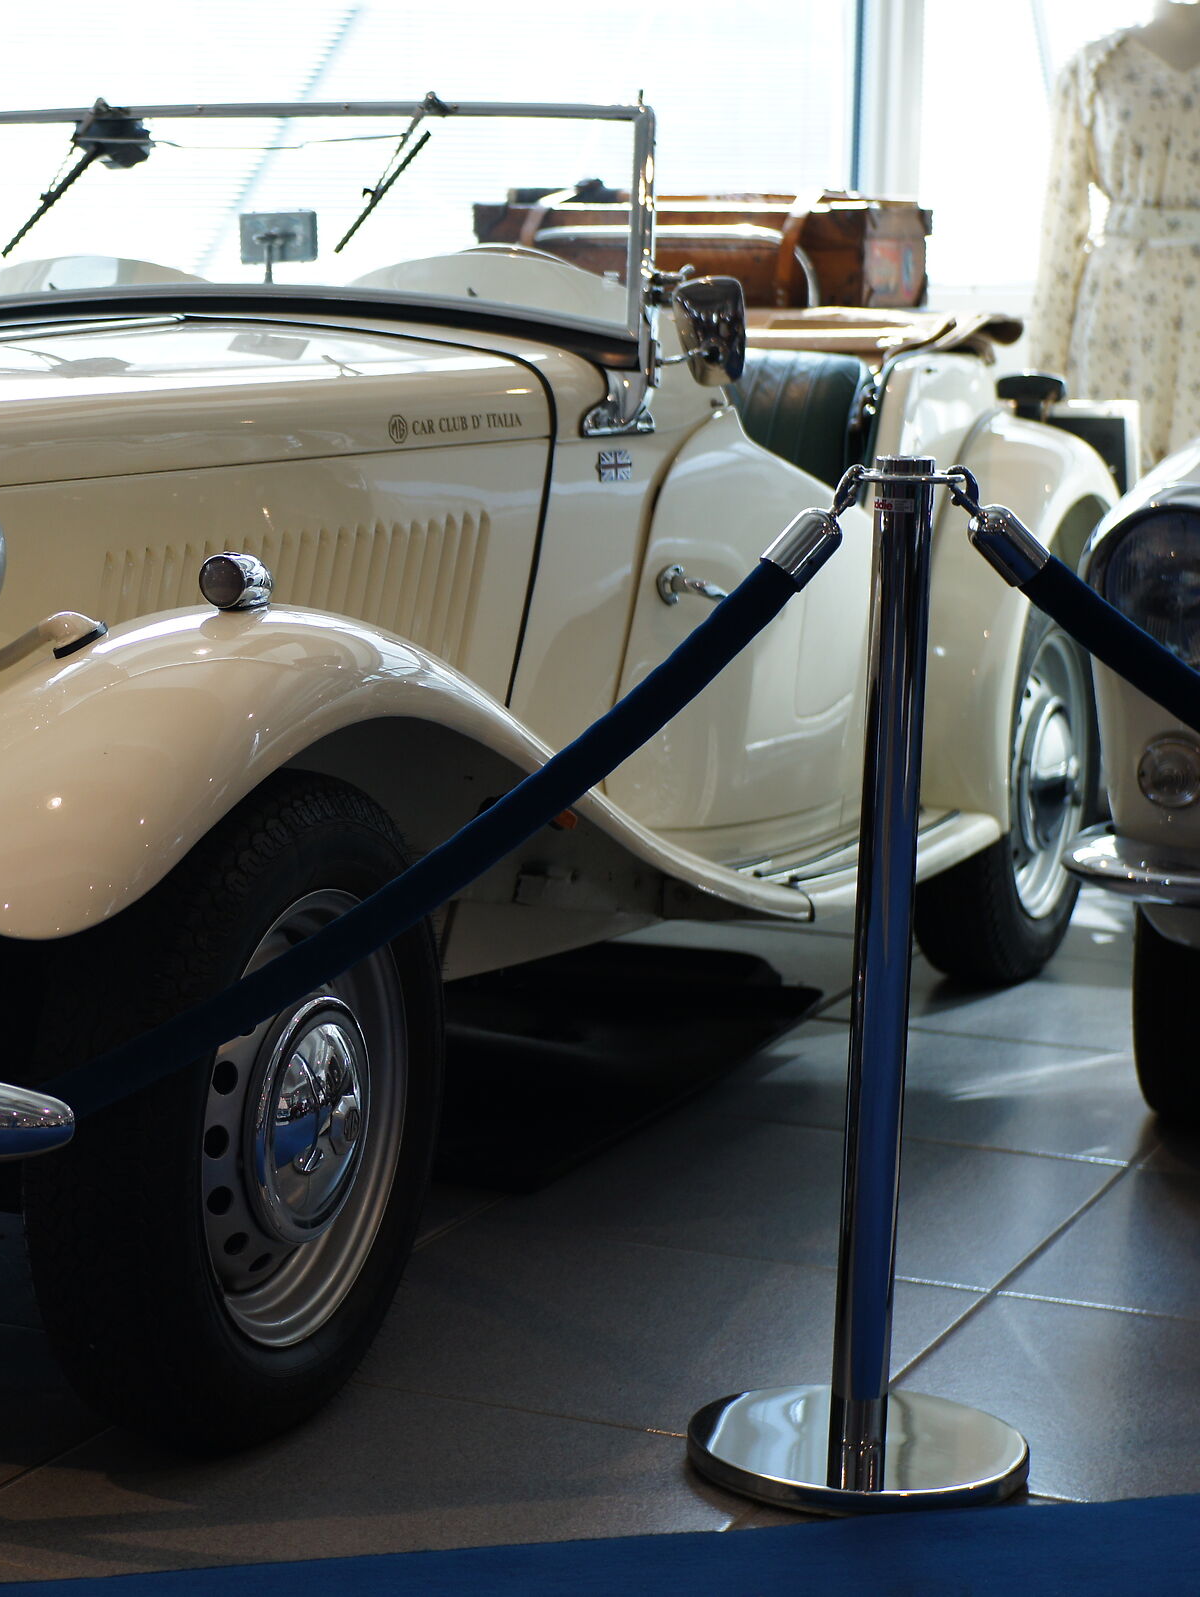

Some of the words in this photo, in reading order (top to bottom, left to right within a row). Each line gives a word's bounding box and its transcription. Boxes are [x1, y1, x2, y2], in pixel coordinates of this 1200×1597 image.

[390, 417, 407, 441] MG
[412, 419, 435, 436] CAR
[438, 416, 468, 433] CLUB
[486, 413, 522, 428] ITALIA
